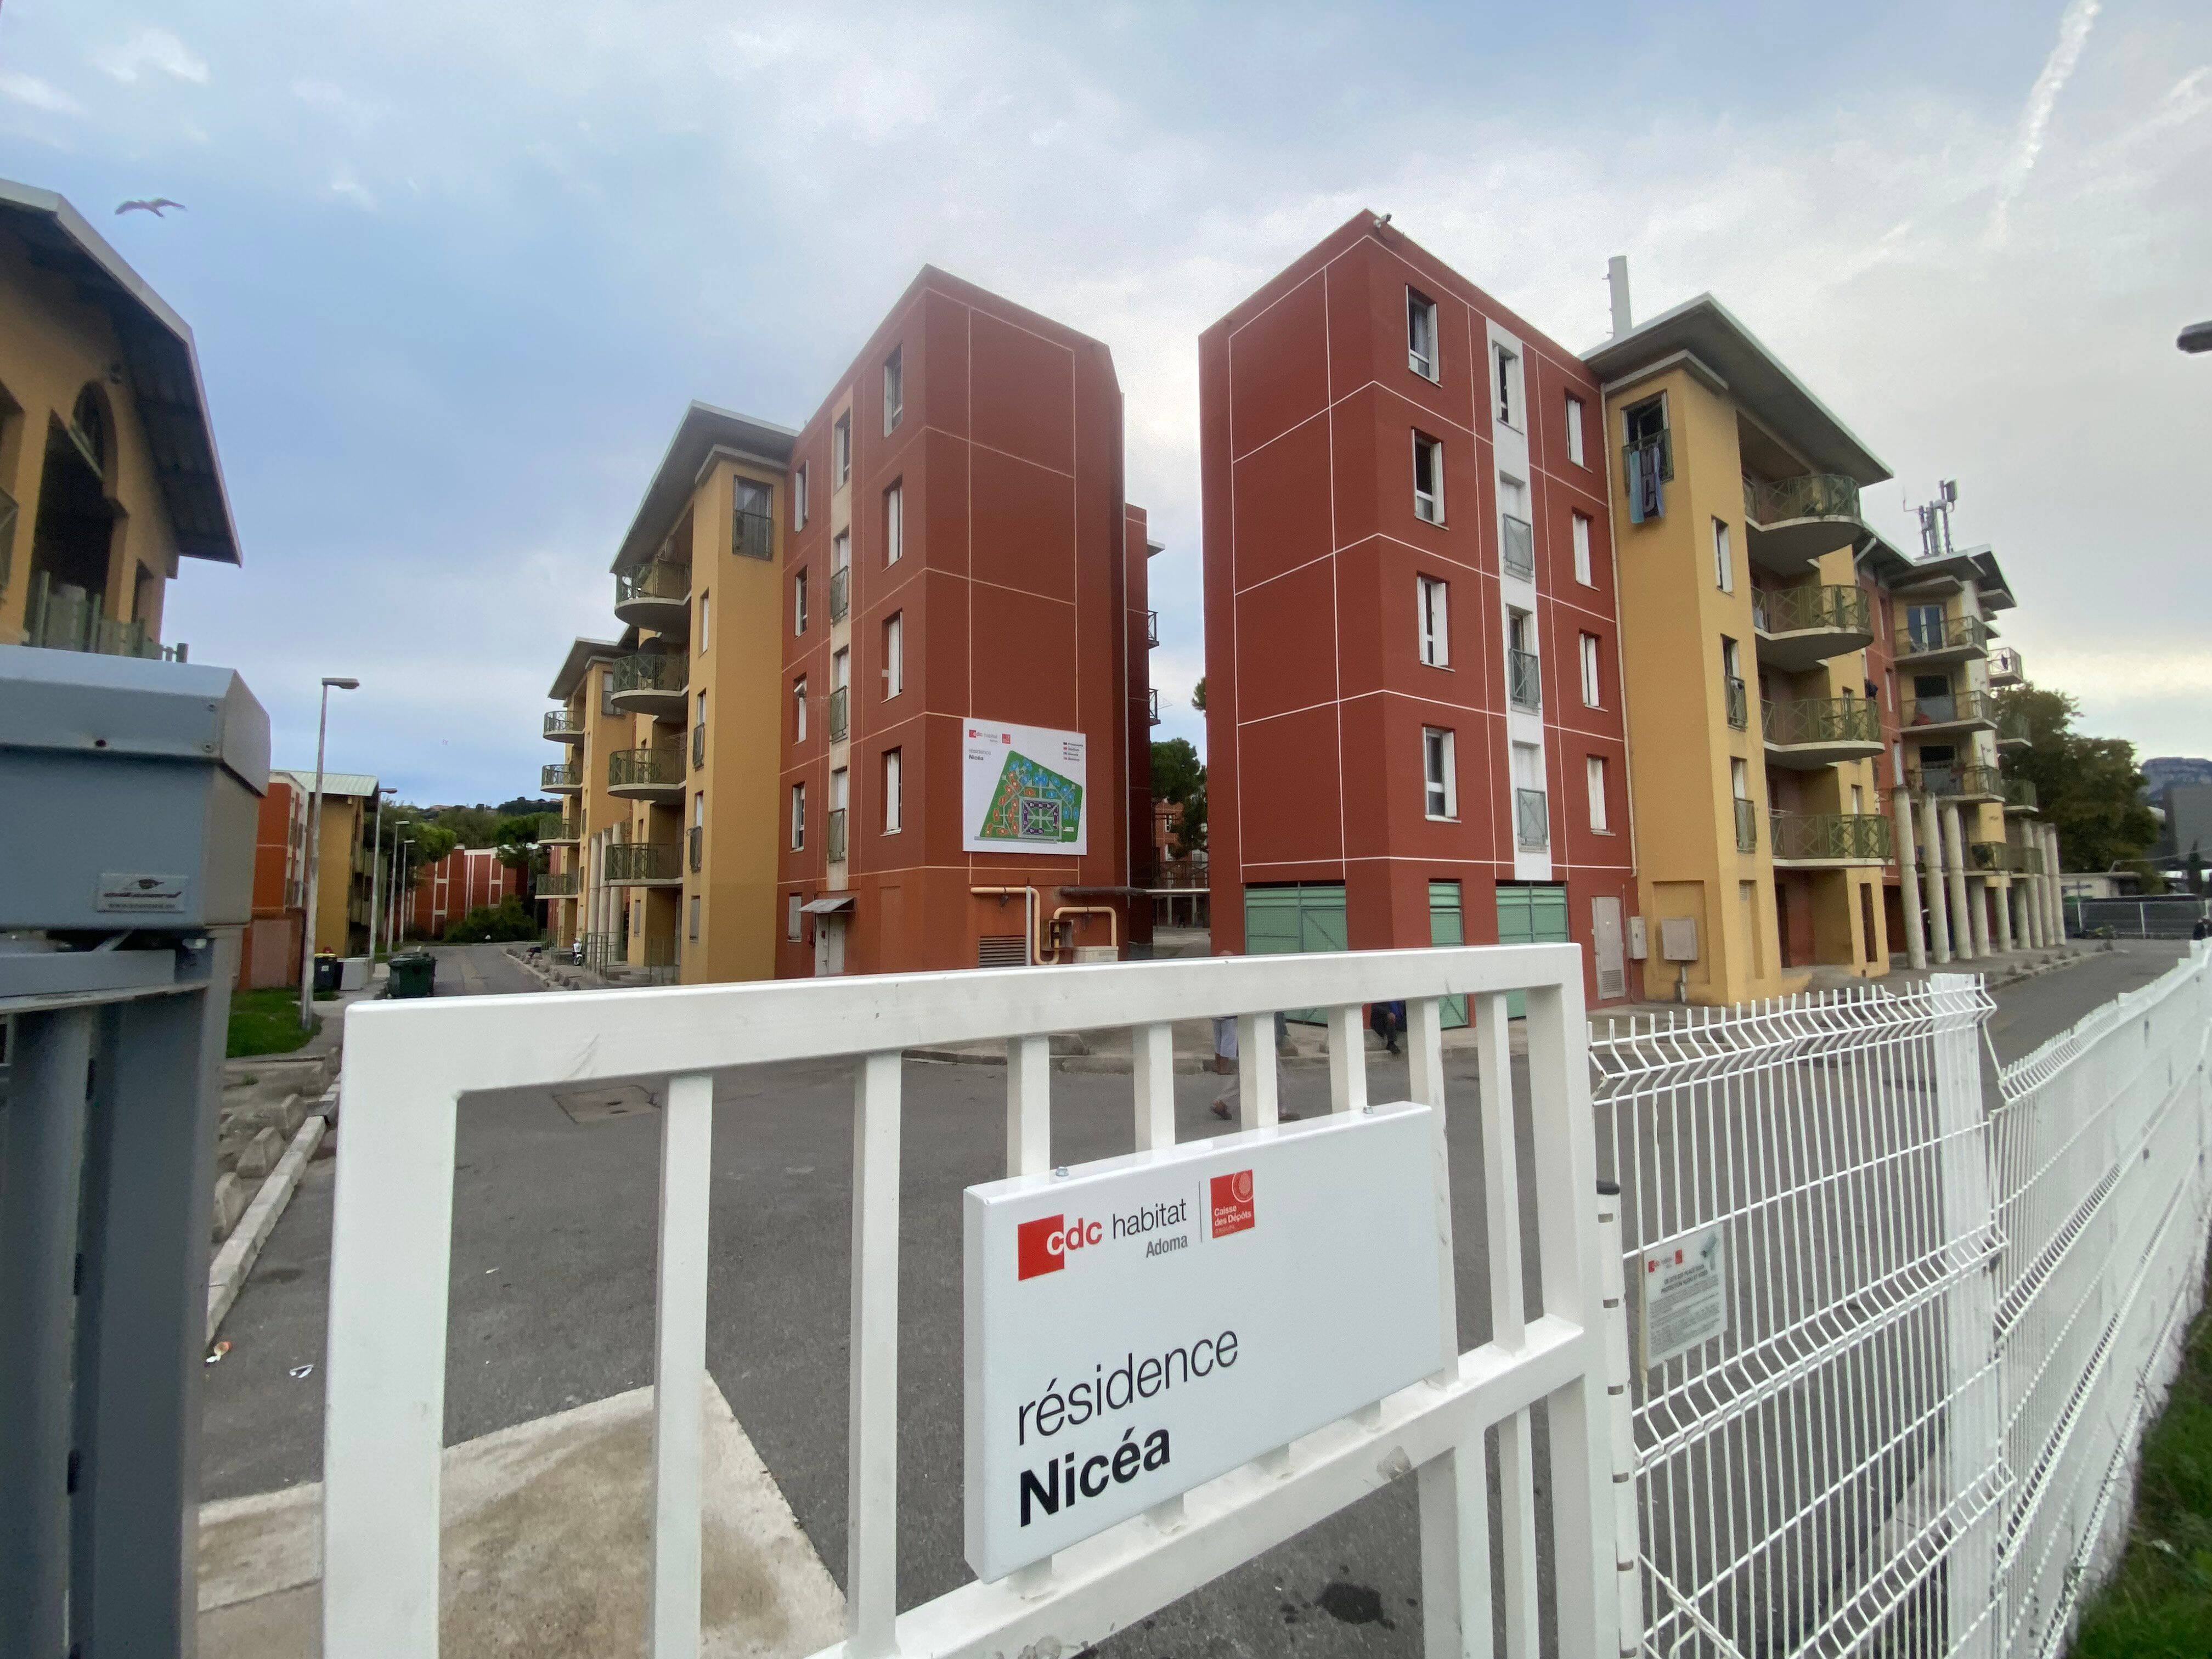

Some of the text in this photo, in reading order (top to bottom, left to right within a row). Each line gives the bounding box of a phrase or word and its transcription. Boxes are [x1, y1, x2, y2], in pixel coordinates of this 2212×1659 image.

[1046, 1198, 1187, 1256] cdc habitat
[1214, 1205, 1237, 1217] Caisse
[1214, 1211, 1251, 1226] des Dépôts
[1146, 1234, 1188, 1258] Adoma
[1019, 1330, 1238, 1446] résidence
[1020, 1426, 1170, 1527] Nicéa
